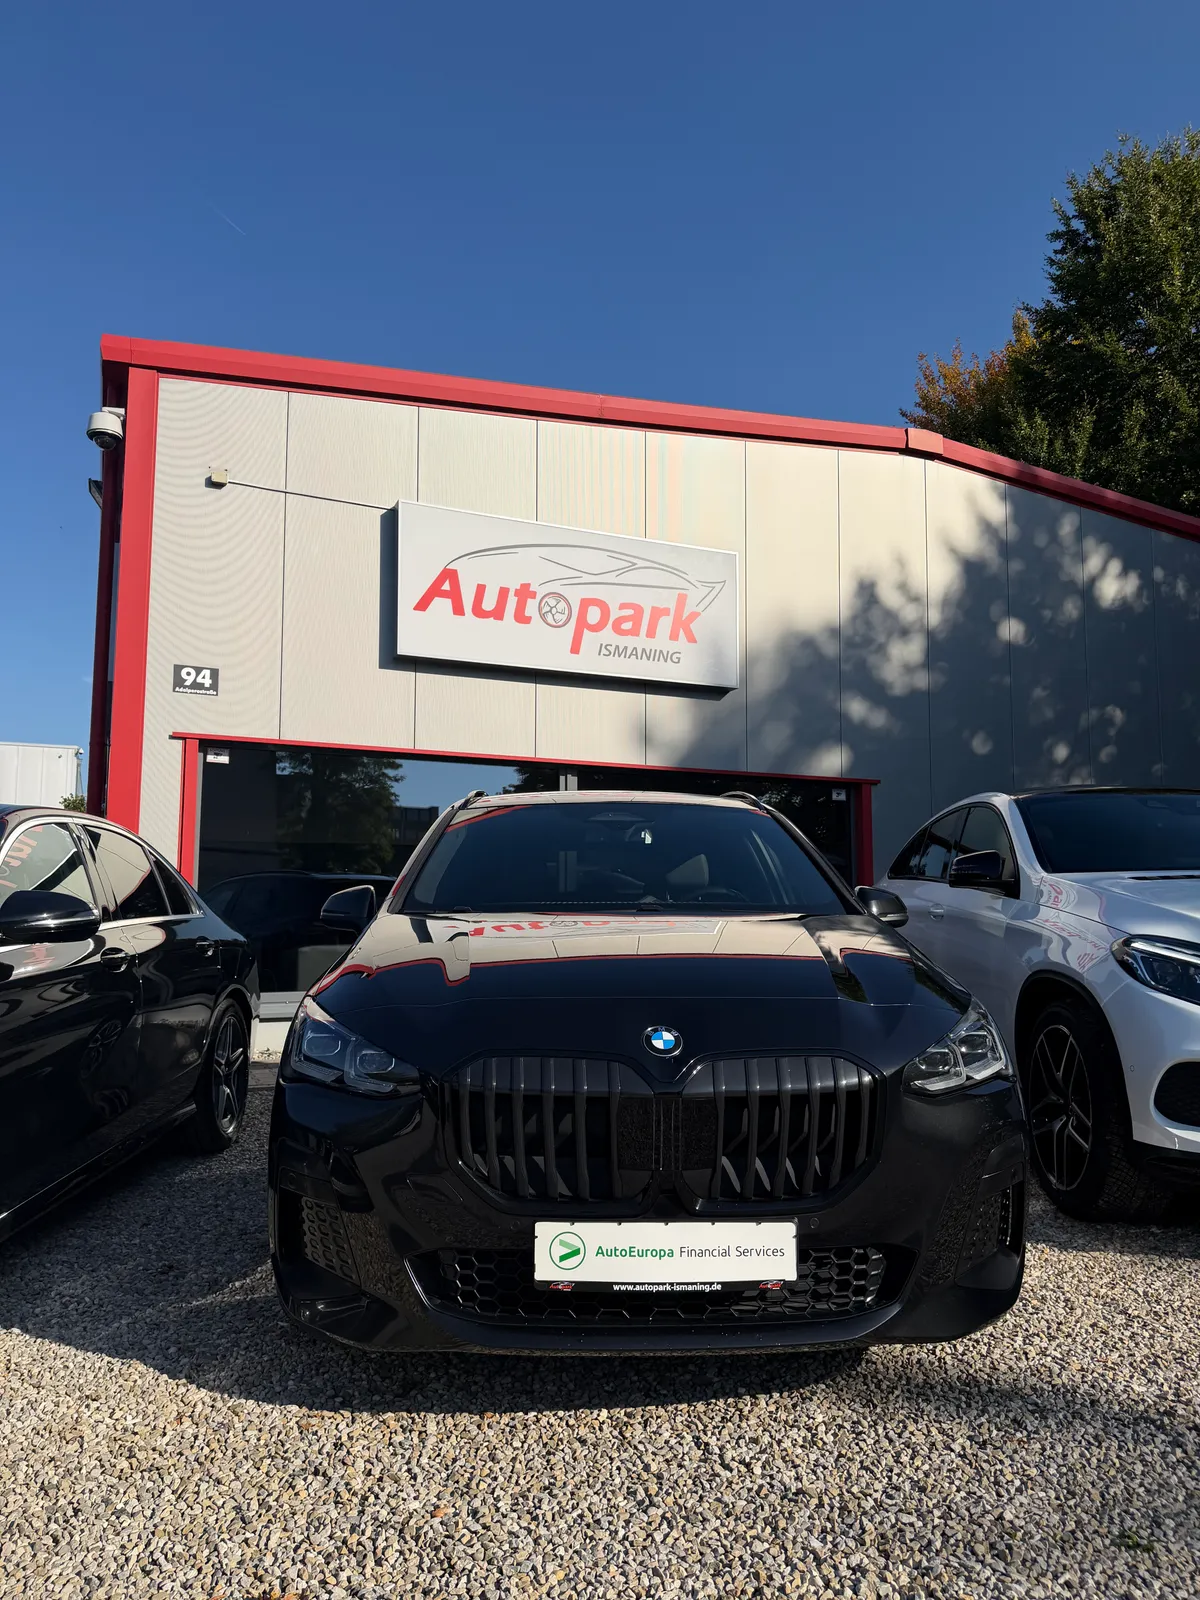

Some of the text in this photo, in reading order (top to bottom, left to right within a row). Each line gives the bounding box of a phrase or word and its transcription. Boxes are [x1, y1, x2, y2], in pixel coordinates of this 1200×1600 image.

[413, 568, 702, 655] Autopark
[598, 643, 682, 664] ISMANING
[180, 667, 212, 688] 94
[595, 1245, 785, 1261] AutoEuropa Financial Services
[613, 1282, 722, 1293] www.autopark-ismaning.de
